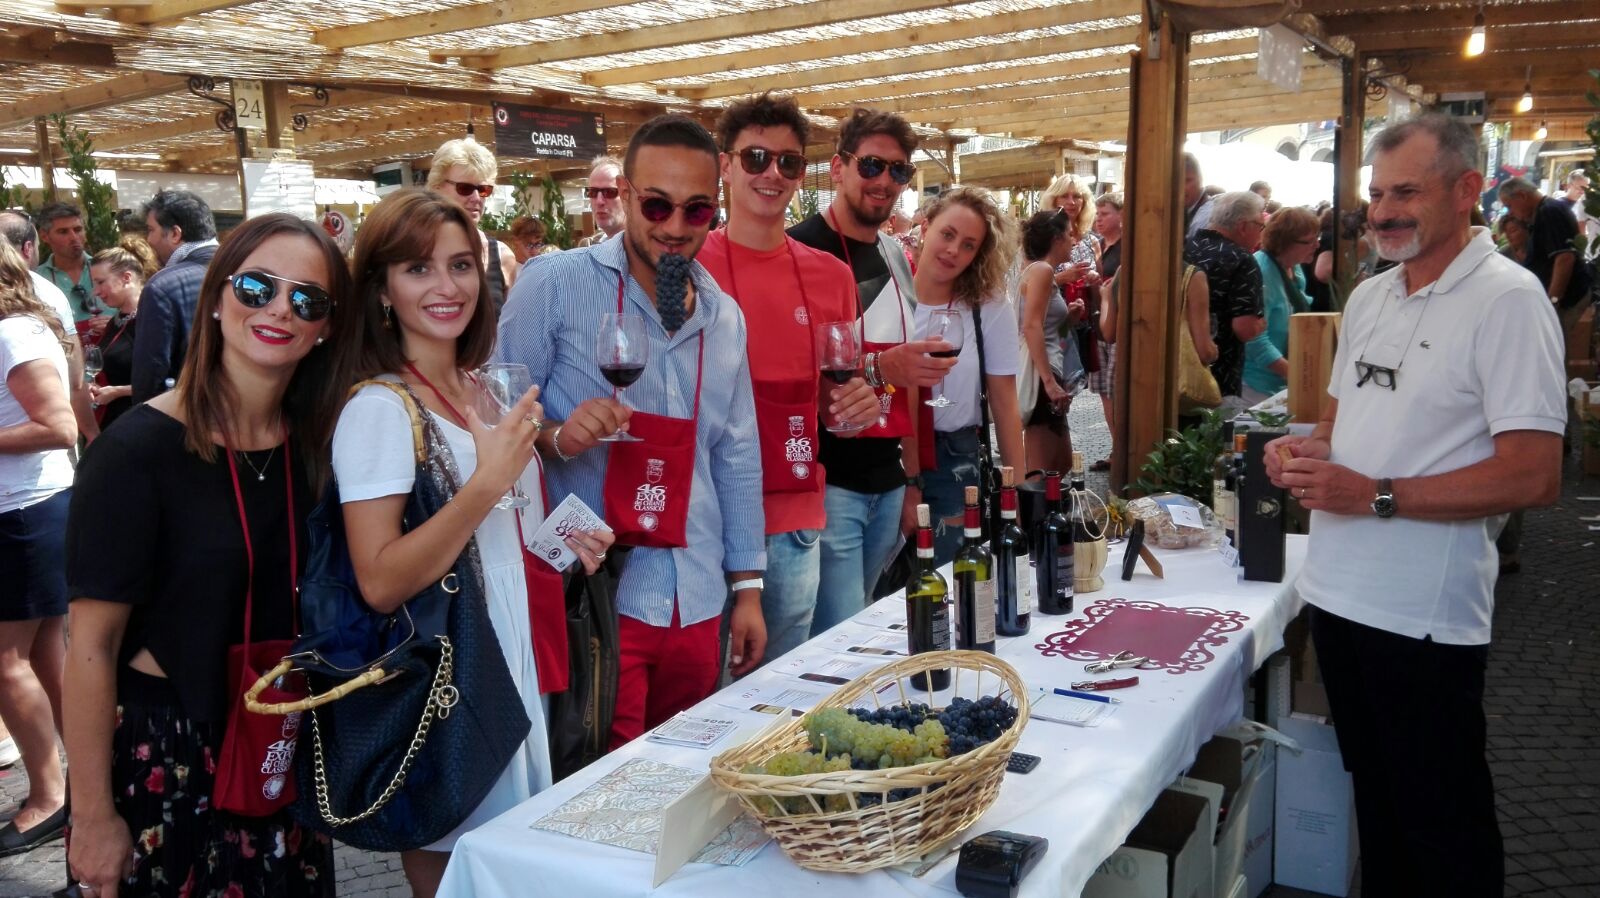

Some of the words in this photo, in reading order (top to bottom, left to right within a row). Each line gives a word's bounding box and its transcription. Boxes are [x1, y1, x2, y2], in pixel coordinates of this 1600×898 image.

[236, 98, 262, 119] 24
[532, 132, 576, 148] CAPARSA
[636, 492, 666, 501] EXPO
